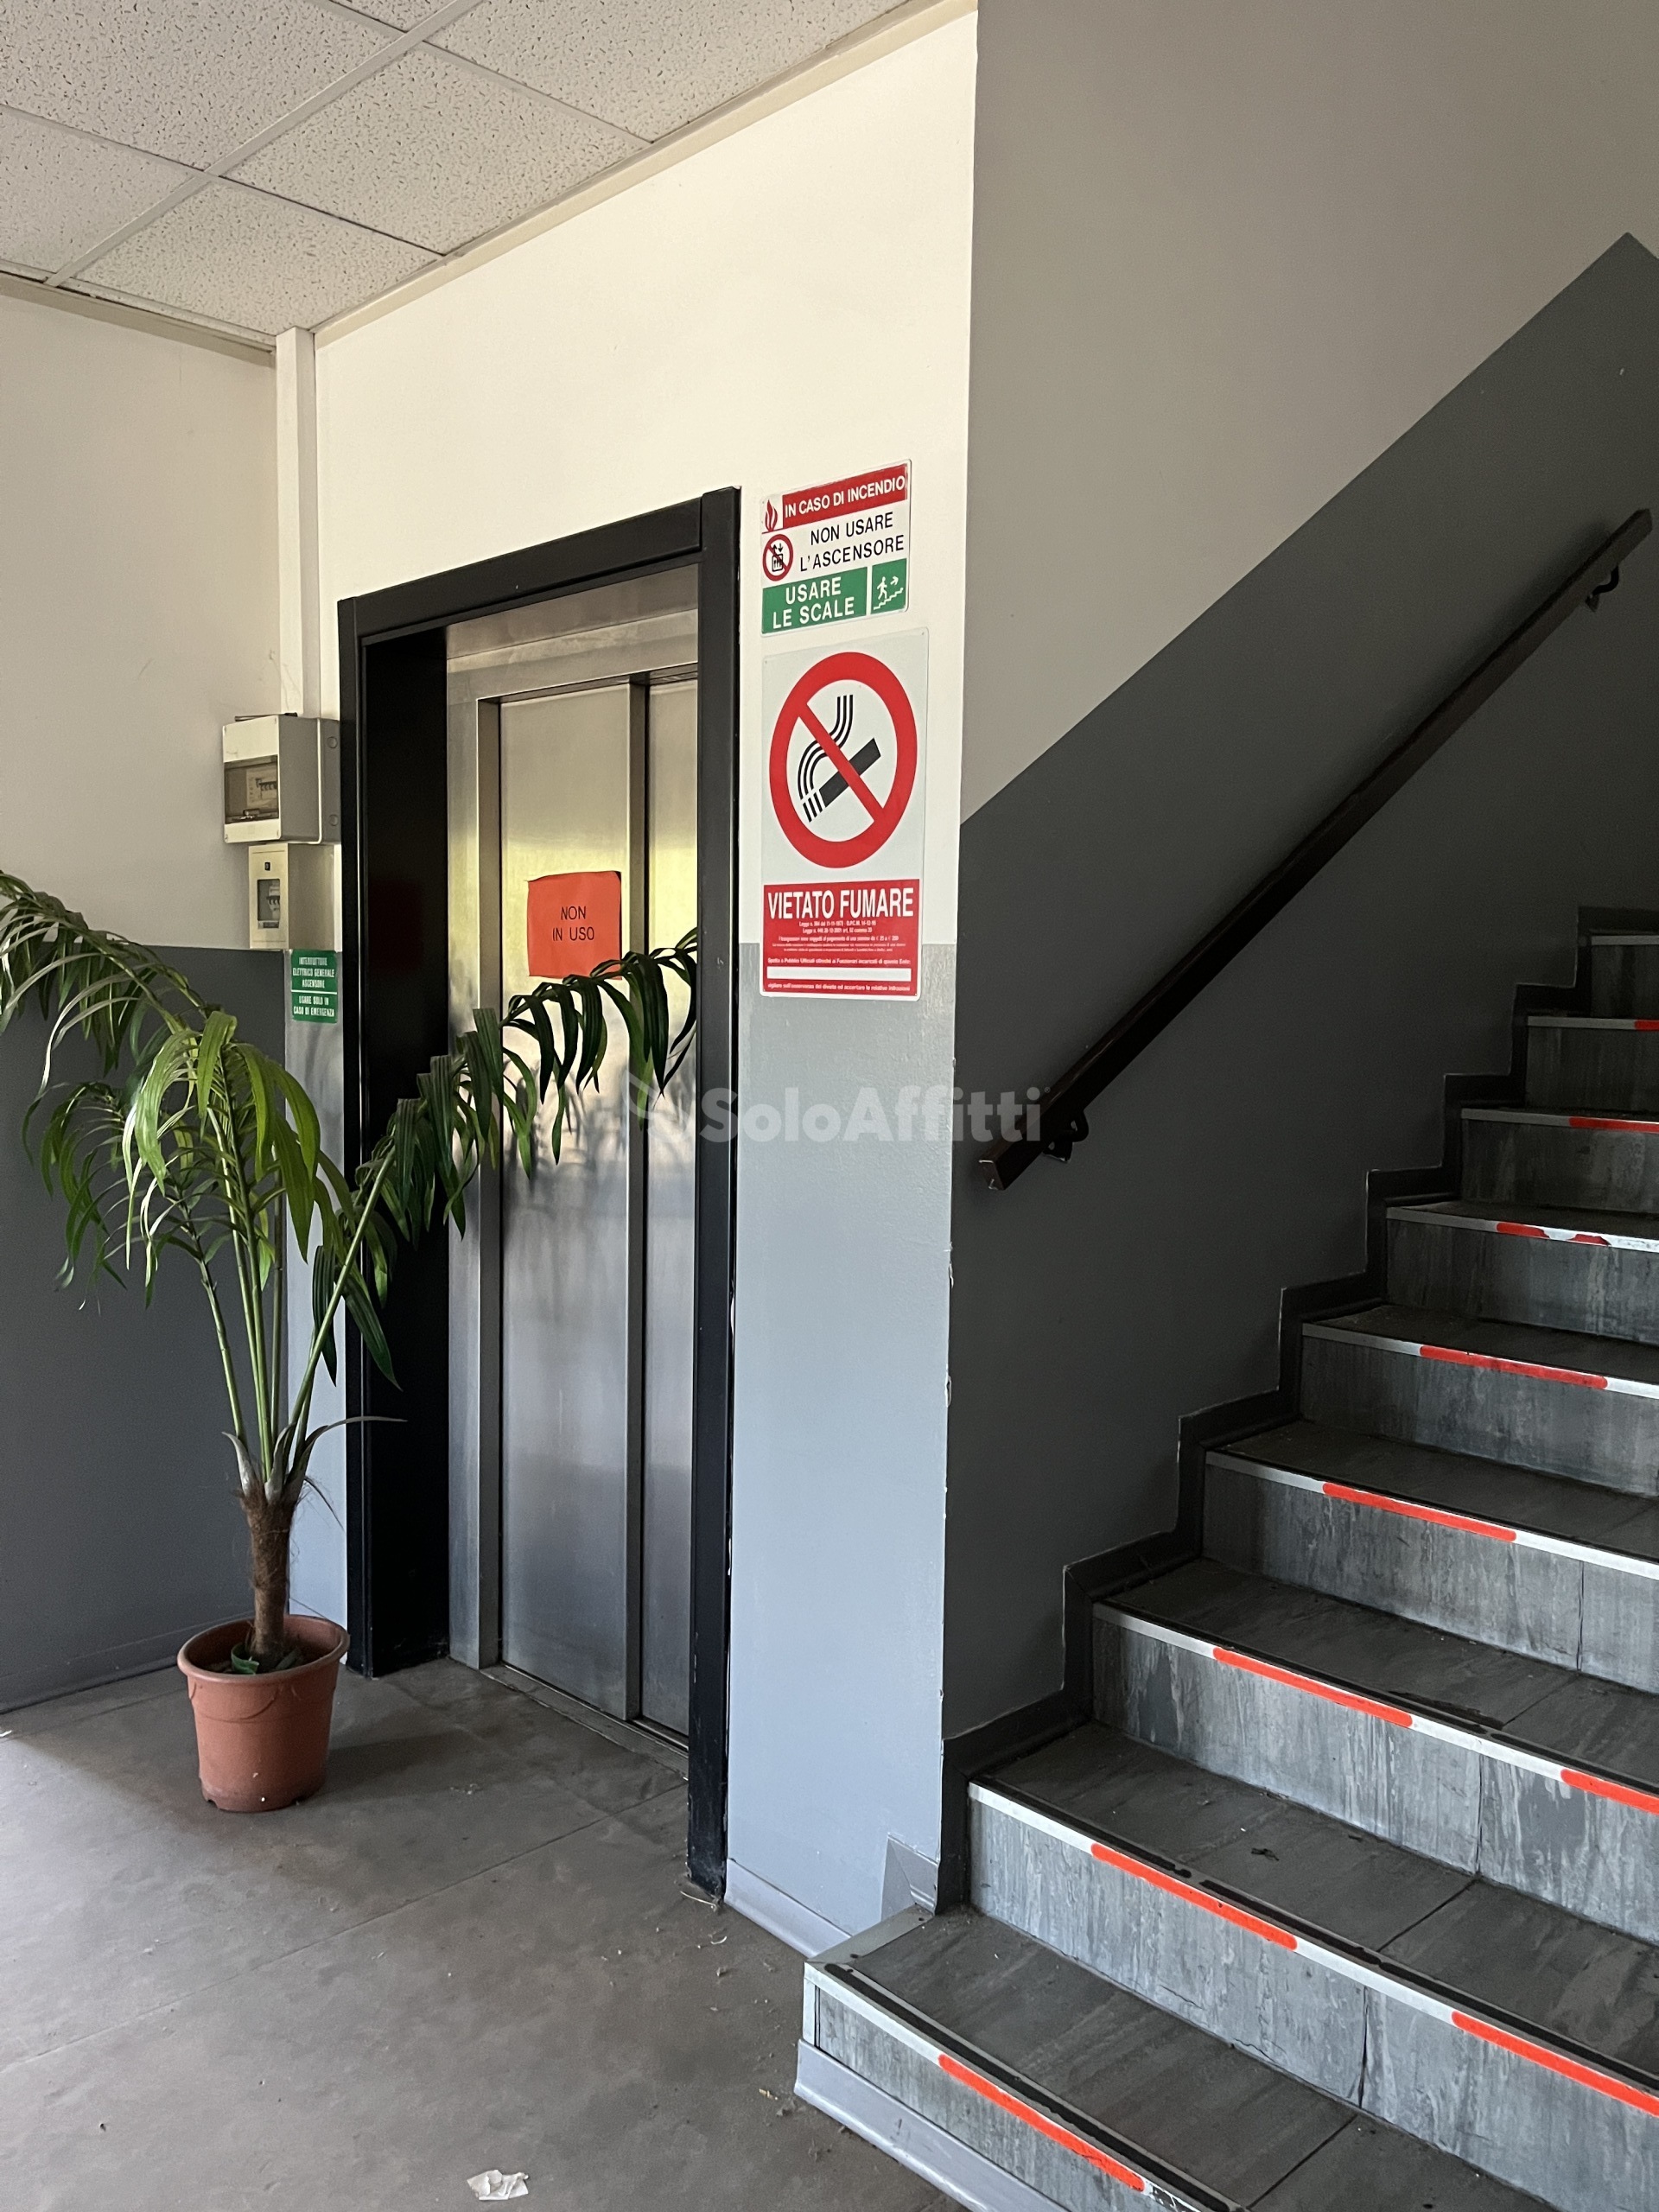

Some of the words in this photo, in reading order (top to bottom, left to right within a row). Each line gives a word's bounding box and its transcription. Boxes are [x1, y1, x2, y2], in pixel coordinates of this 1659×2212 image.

[785, 504, 797, 518] IN
[798, 494, 830, 515] CASO
[833, 491, 845, 507] DI
[848, 475, 906, 503] INCENDIO
[810, 524, 840, 545] NON
[846, 512, 893, 537] USARE
[800, 534, 904, 572] L'ASCENSORE
[785, 576, 842, 605] USARE
[772, 608, 792, 629] LE
[799, 597, 855, 624] SCALE
[561, 906, 587, 920] NON
[767, 890, 835, 919] VIETATO
[839, 887, 914, 918] FUMARE
[552, 927, 563, 941] IN
[569, 926, 594, 941] USO
